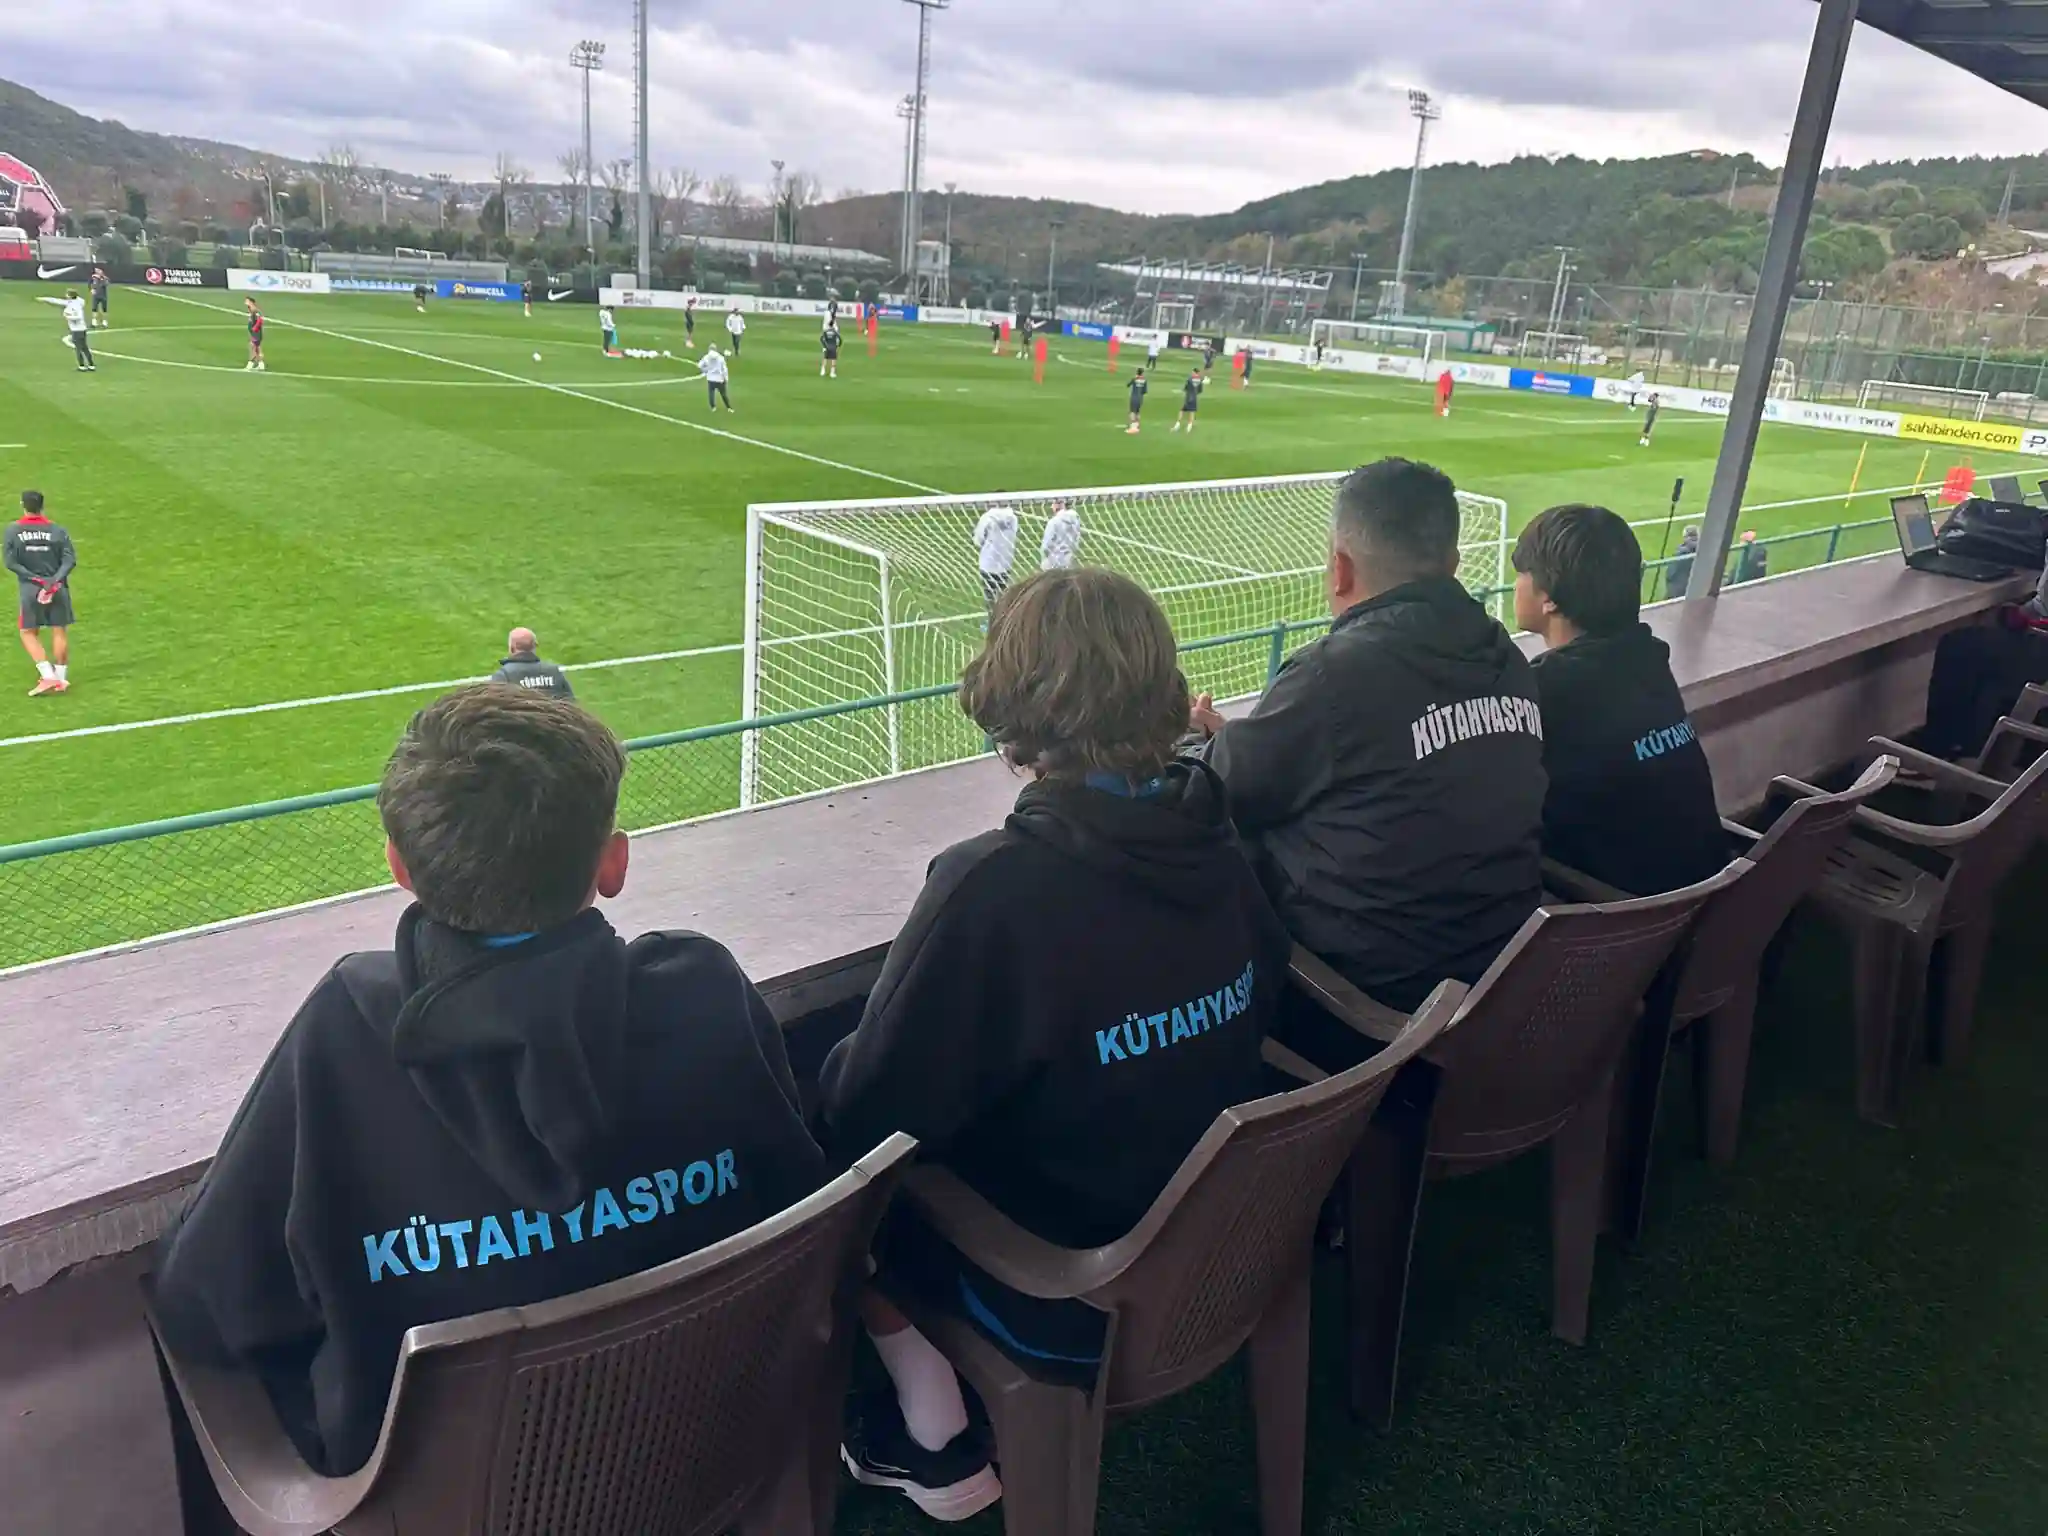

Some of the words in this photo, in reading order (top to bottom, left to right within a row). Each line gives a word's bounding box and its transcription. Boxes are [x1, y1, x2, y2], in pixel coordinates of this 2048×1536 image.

[1904, 422, 2018, 445] sahibinden.com
[1411, 696, 1544, 761] KÜTAHYASPOR
[362, 1148, 739, 1283] KÜTAHYASPOR
